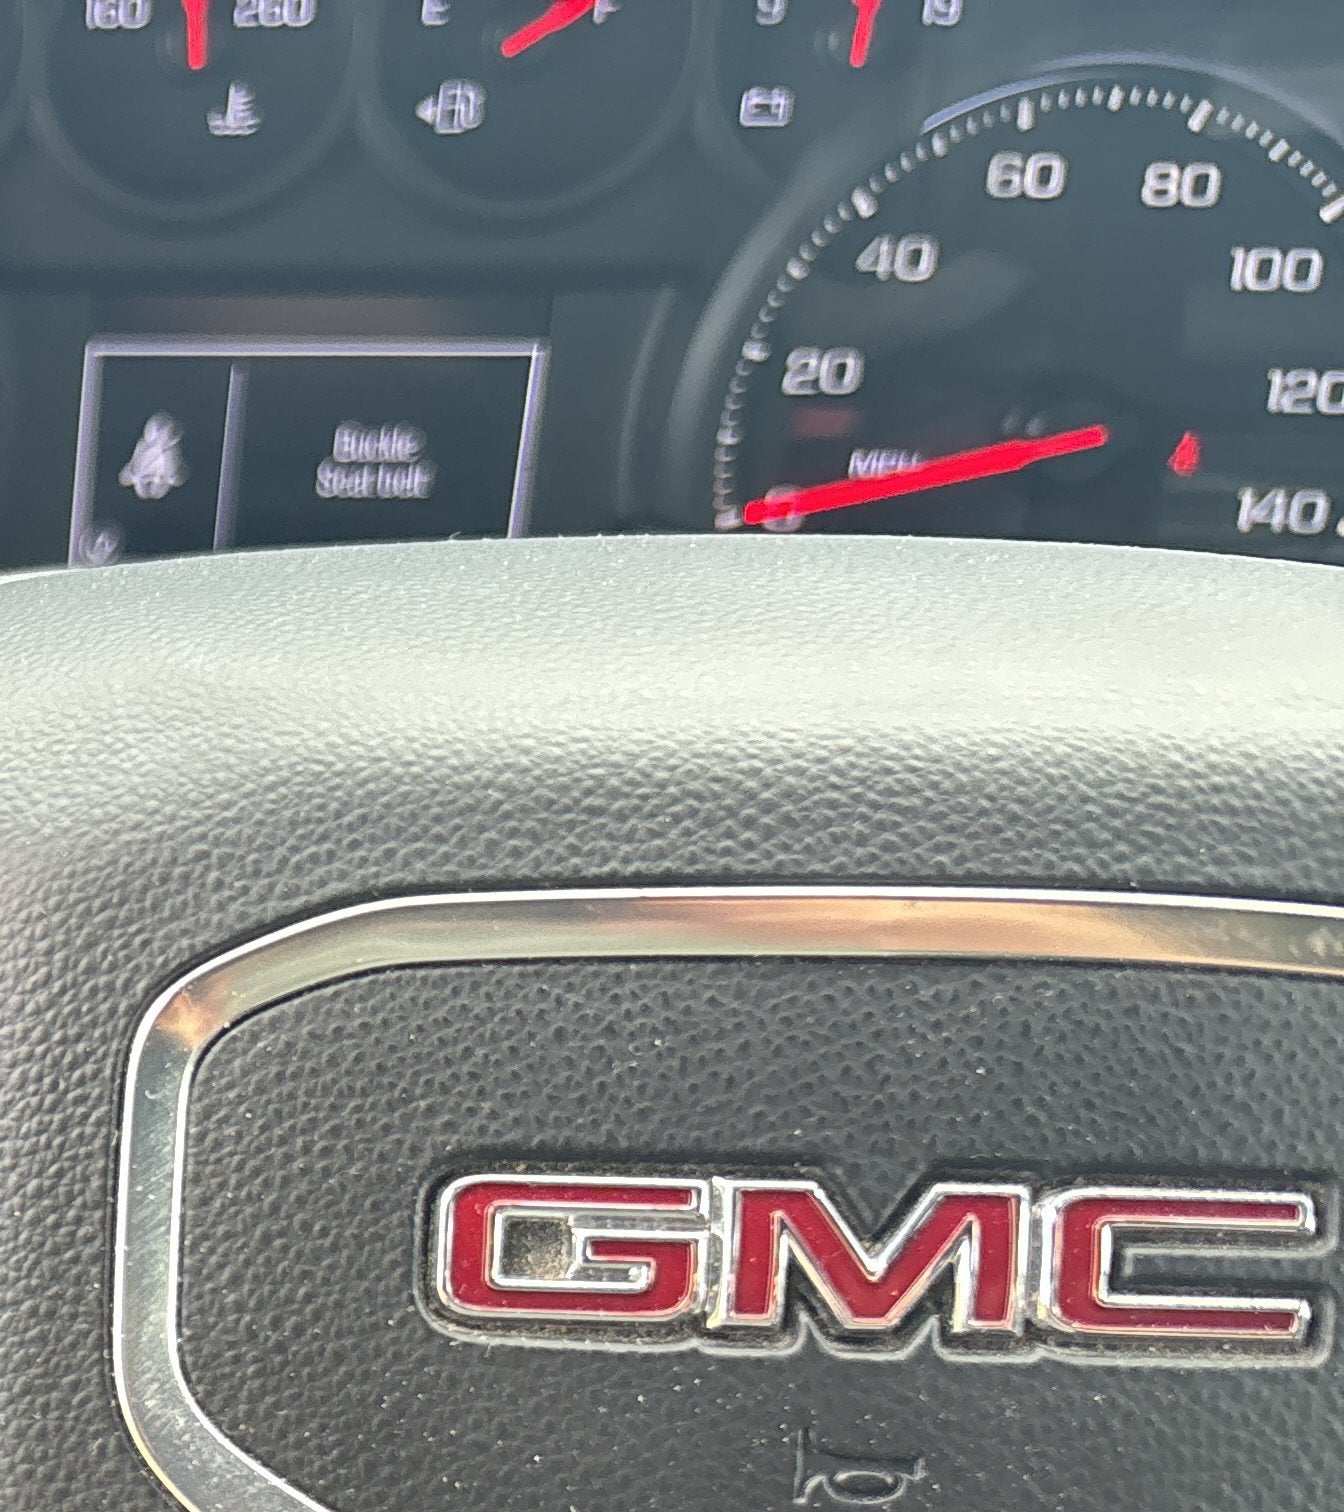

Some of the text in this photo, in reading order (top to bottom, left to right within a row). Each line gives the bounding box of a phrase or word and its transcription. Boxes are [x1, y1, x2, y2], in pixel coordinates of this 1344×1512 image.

[986, 152, 1068, 199] 60
[1141, 162, 1222, 208] 80
[856, 234, 939, 283] 40
[1230, 246, 1324, 292] 100
[782, 347, 865, 397] 20
[1267, 367, 1344, 415] 120
[1237, 486, 1330, 535] 140
[437, 1173, 1316, 1339] GMC
